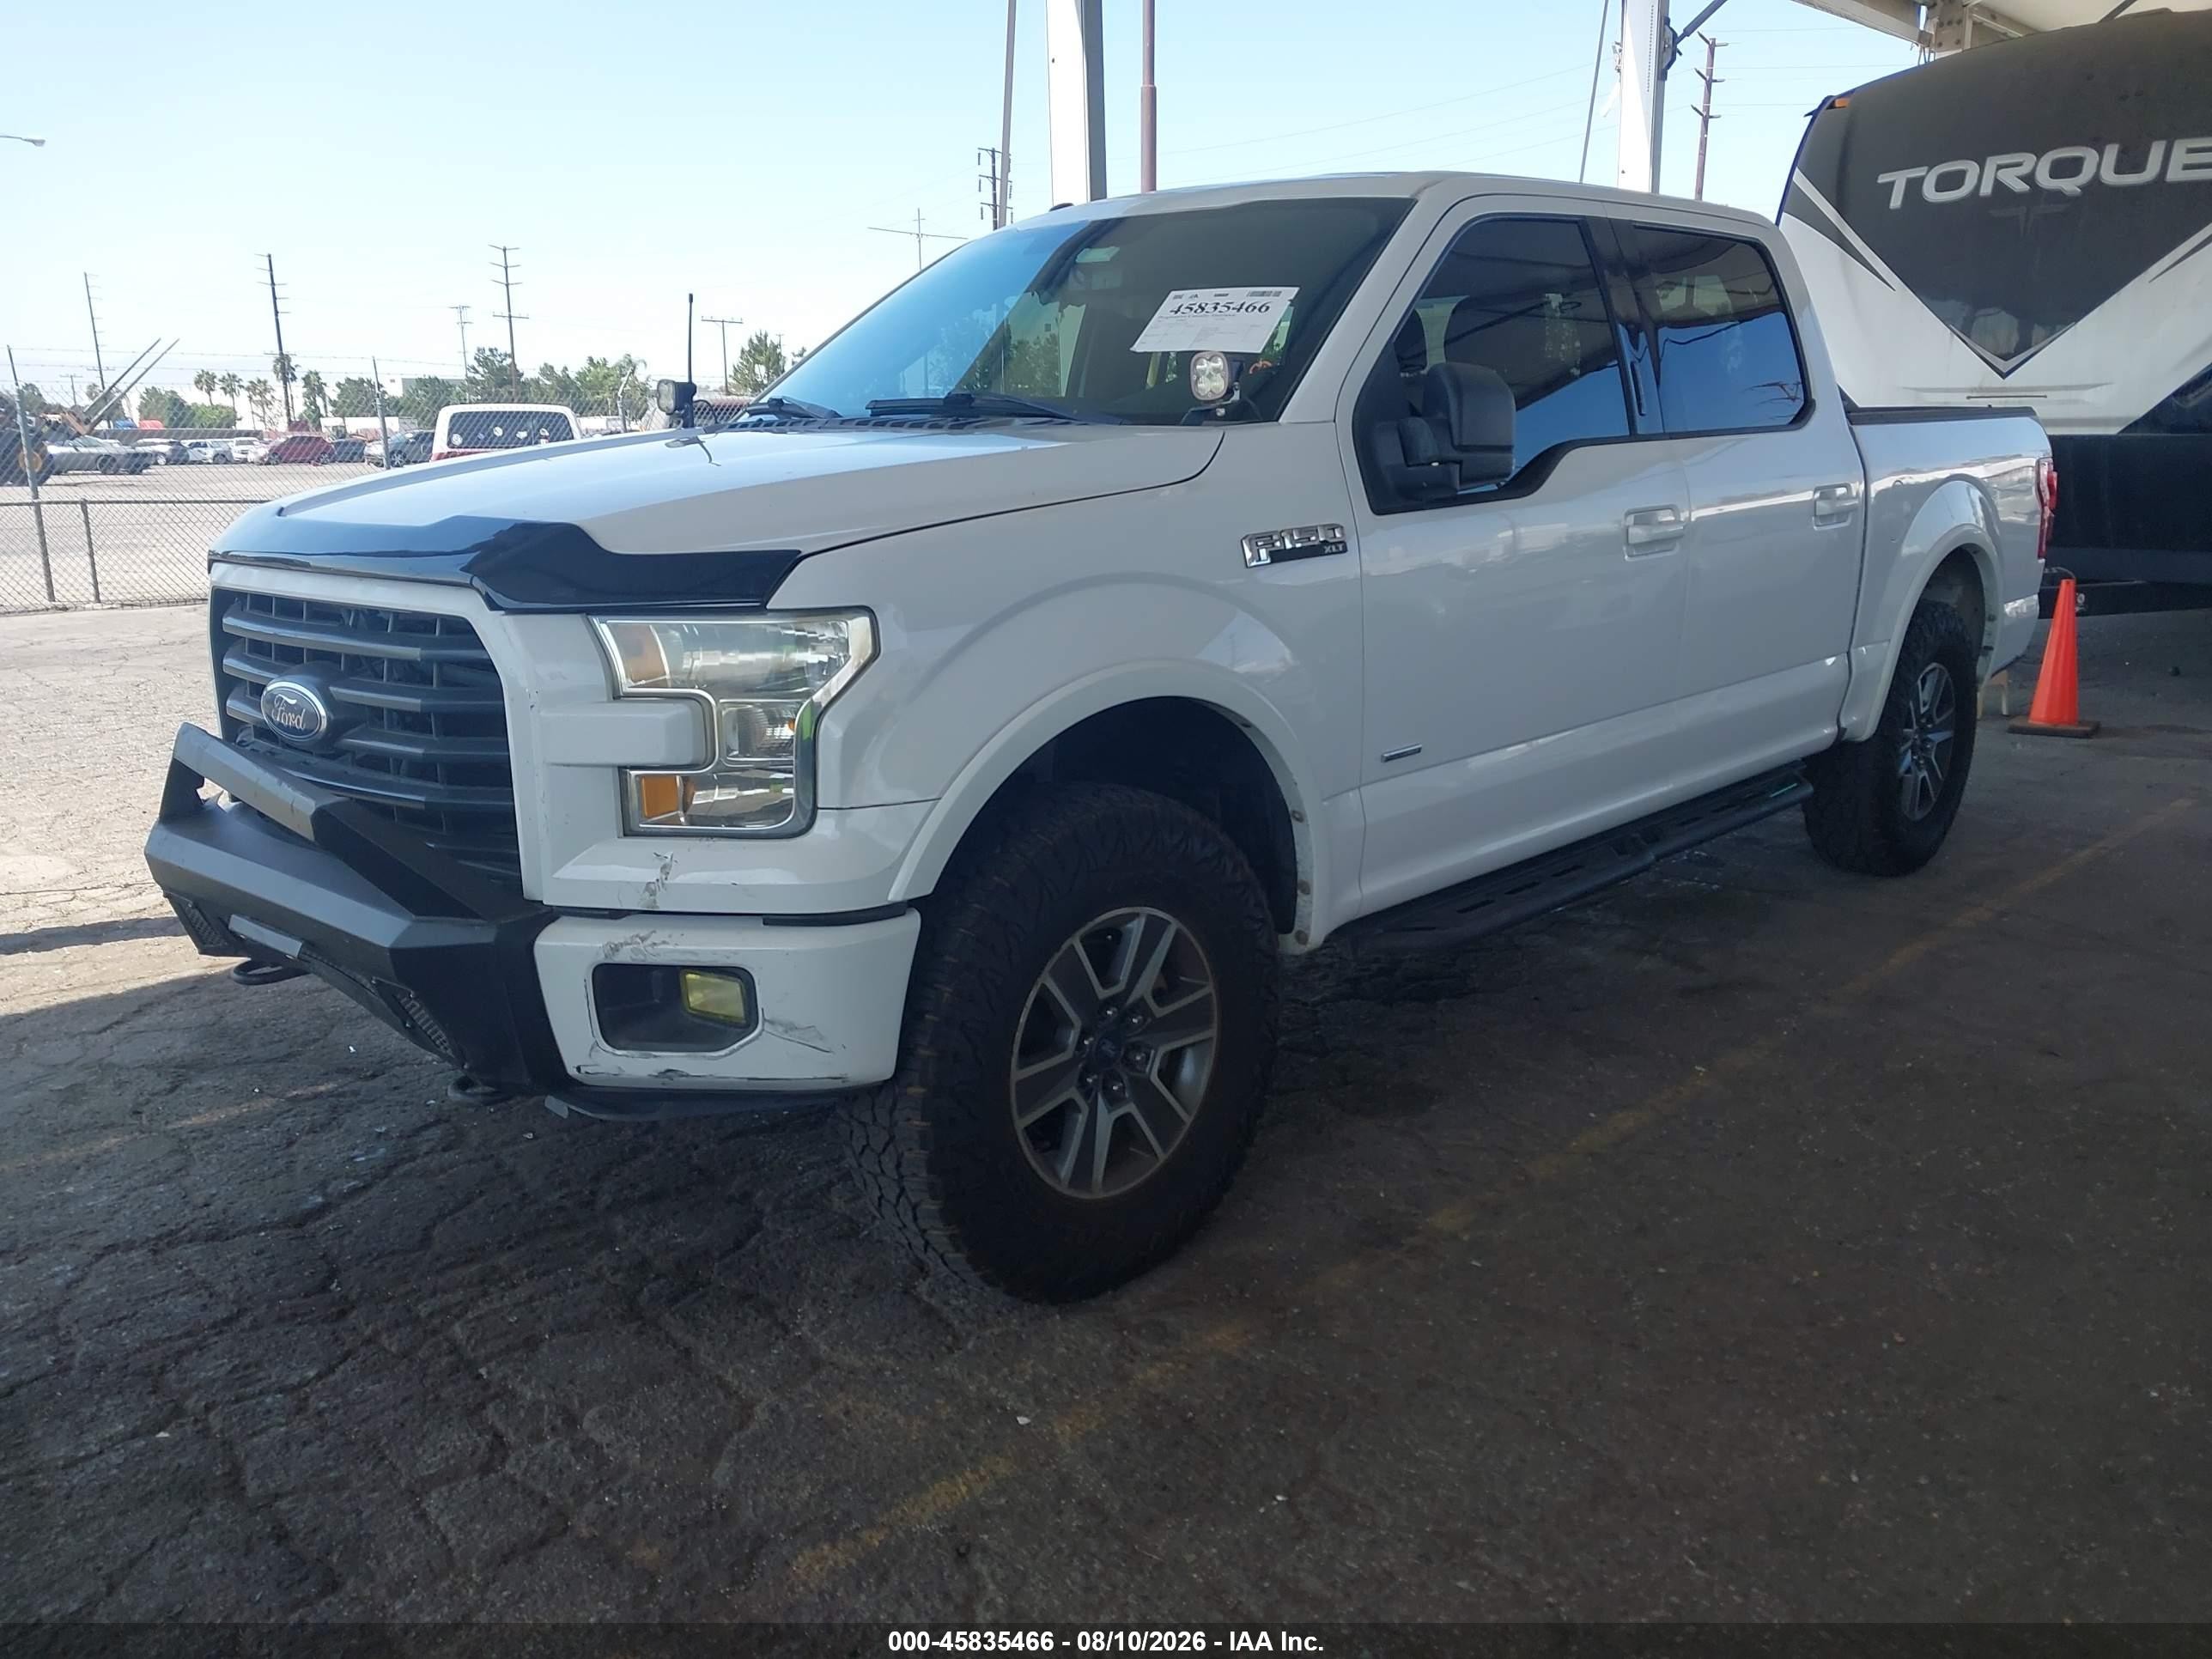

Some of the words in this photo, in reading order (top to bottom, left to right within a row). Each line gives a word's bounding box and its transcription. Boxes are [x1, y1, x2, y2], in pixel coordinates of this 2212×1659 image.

[1877, 137, 2212, 210] TORQUE
[1170, 301, 1272, 314] 45835466
[1323, 543, 1345, 555] XLT
[271, 694, 307, 730] Ford
